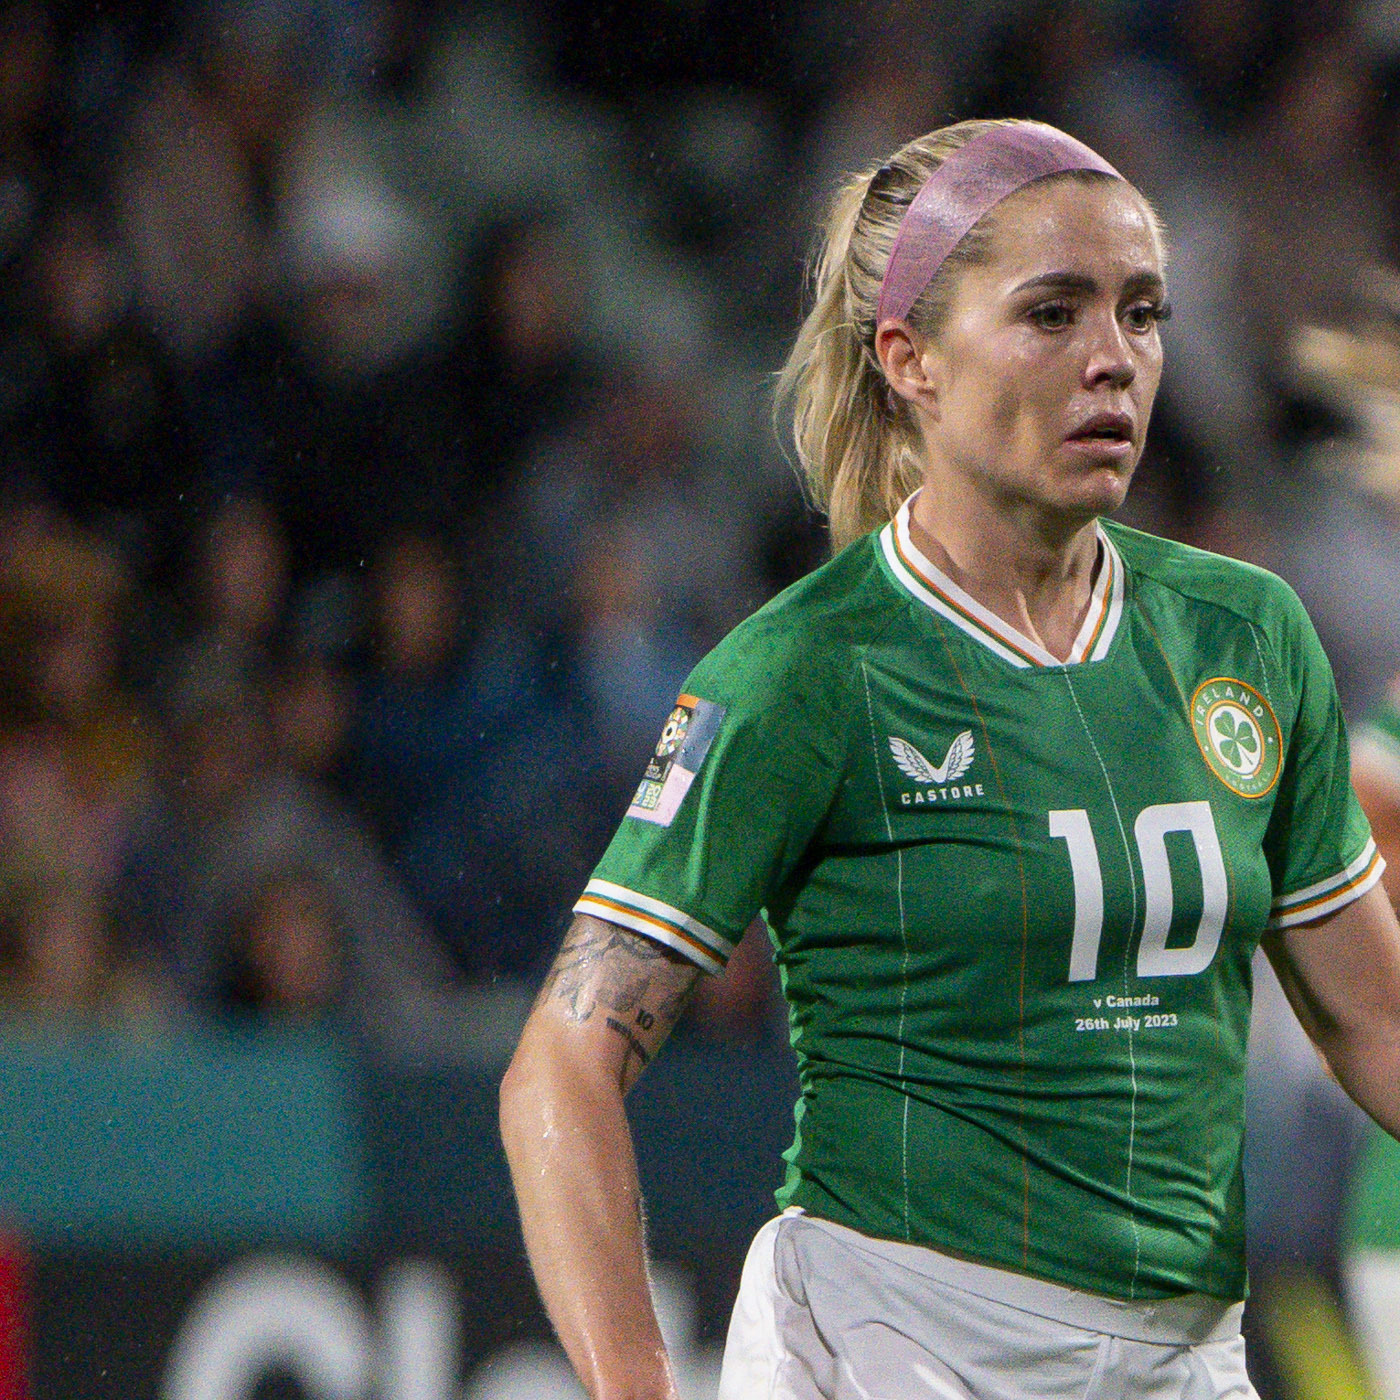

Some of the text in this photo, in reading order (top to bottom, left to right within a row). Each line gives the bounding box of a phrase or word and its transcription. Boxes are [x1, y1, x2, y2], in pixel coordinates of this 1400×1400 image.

[1195, 686, 1264, 726] IRELAND
[901, 784, 985, 805] CASTORE
[1049, 801, 1229, 982] 10
[1106, 994, 1160, 1008] Canada
[1075, 1013, 1178, 1032] 26th July 2023
